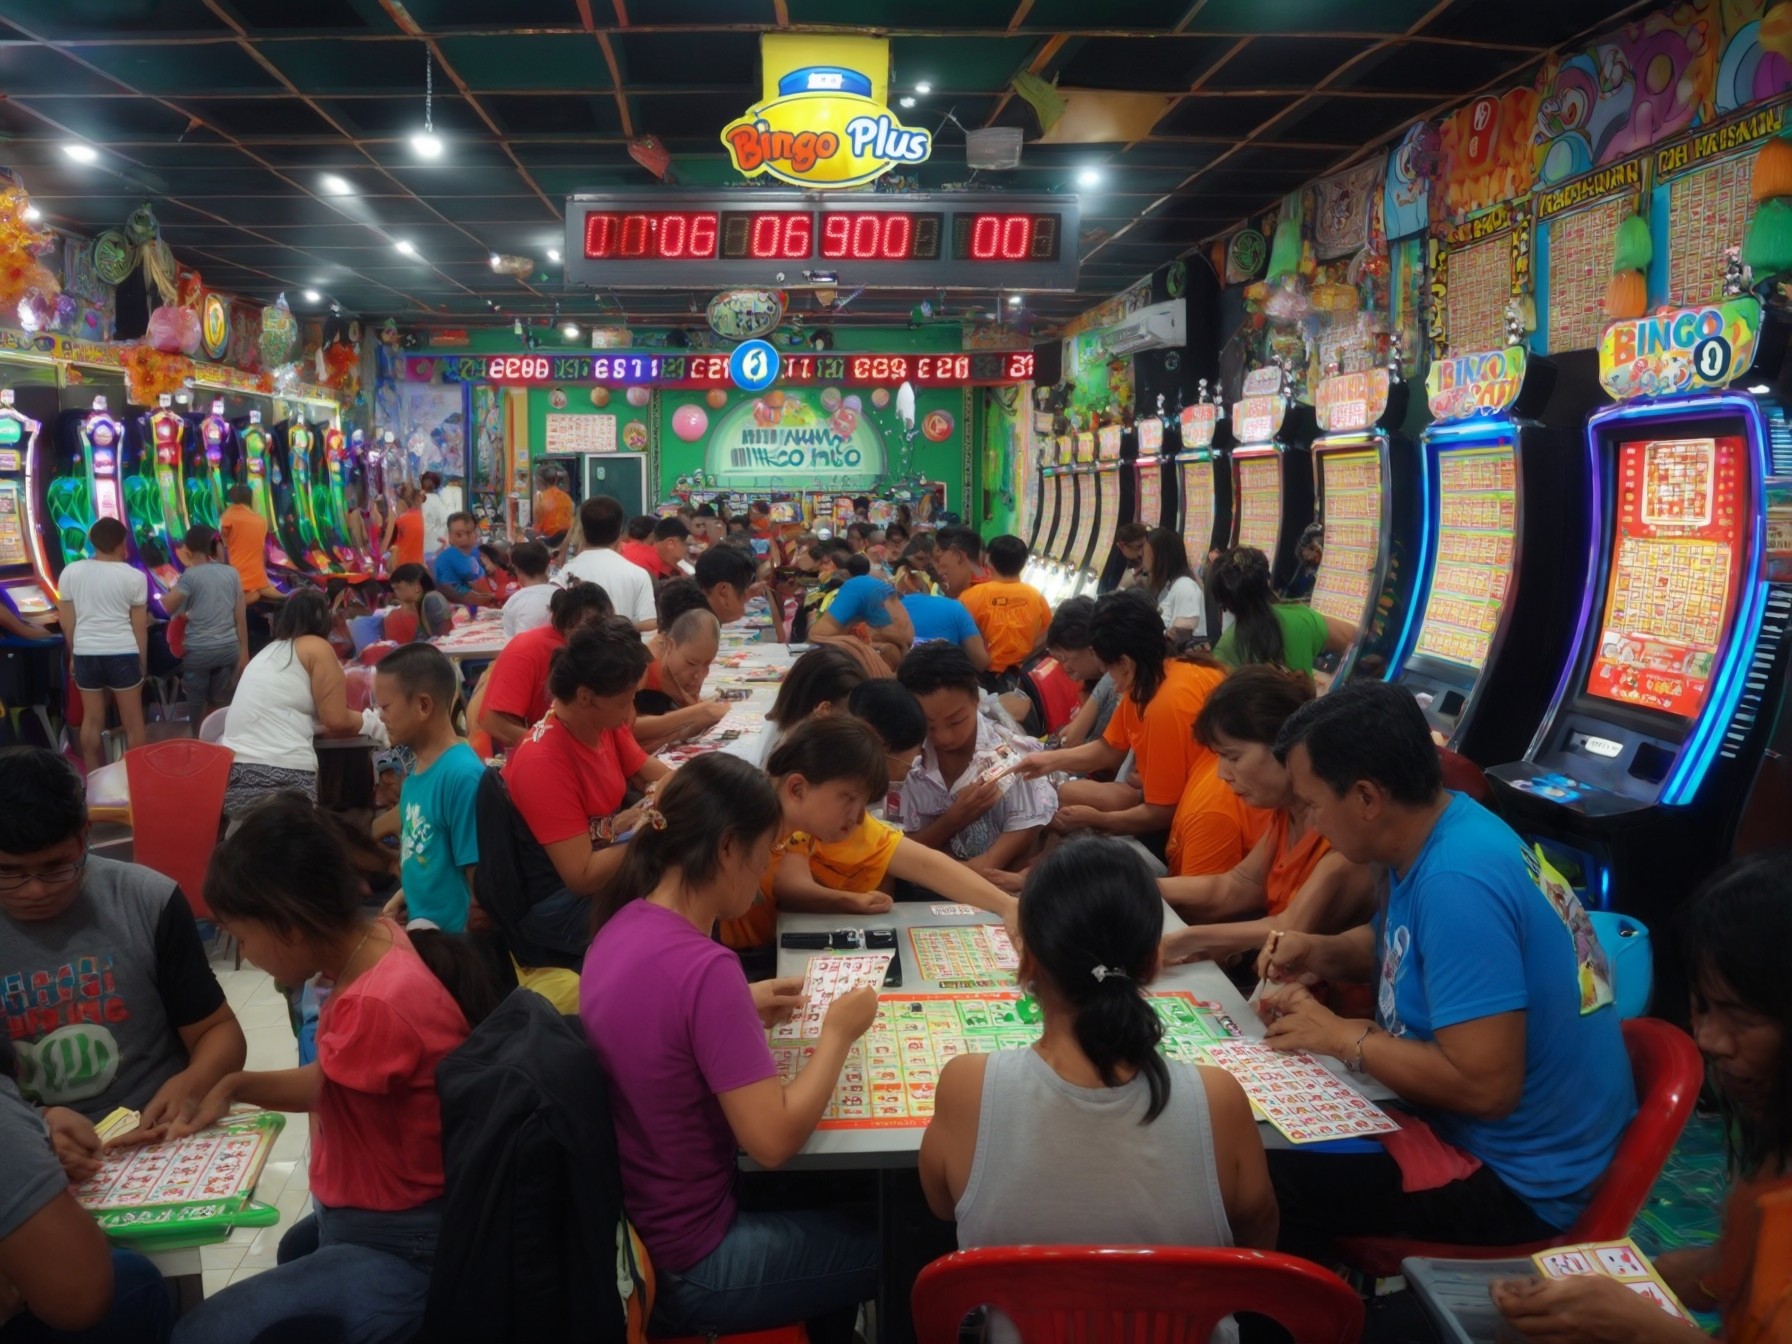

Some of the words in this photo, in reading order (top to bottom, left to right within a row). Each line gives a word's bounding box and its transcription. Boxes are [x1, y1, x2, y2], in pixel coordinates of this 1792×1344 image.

[726, 119, 840, 172] Bingo
[846, 114, 930, 162] Plus
[1612, 309, 1724, 368] BINGO
